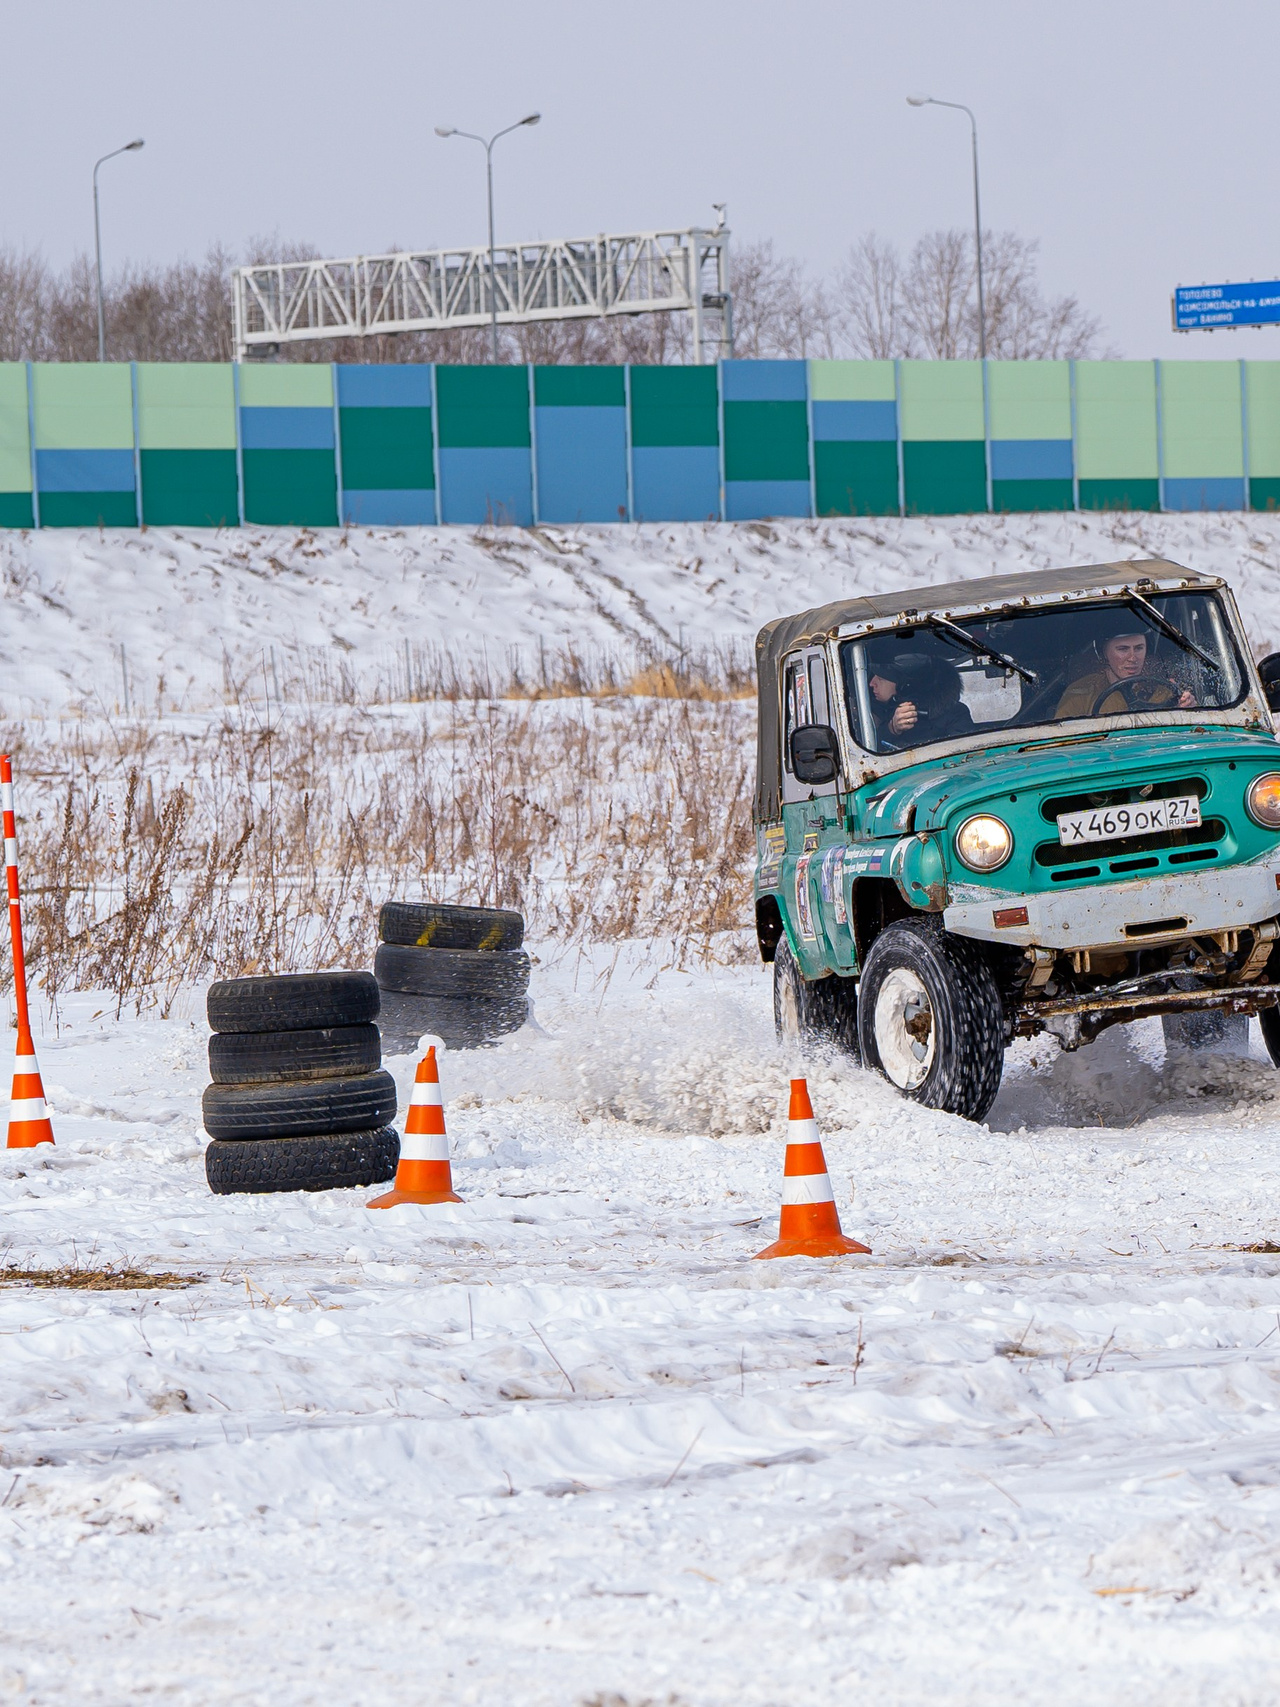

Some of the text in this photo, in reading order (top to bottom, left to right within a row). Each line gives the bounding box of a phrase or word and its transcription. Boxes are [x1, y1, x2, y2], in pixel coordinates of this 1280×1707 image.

[1179, 289, 1222, 299] ТОПОЛЕВО
[1200, 312, 1233, 324] ВАНИНО
[1168, 801, 1189, 818] 27
[1168, 818, 1185, 826] RUS
